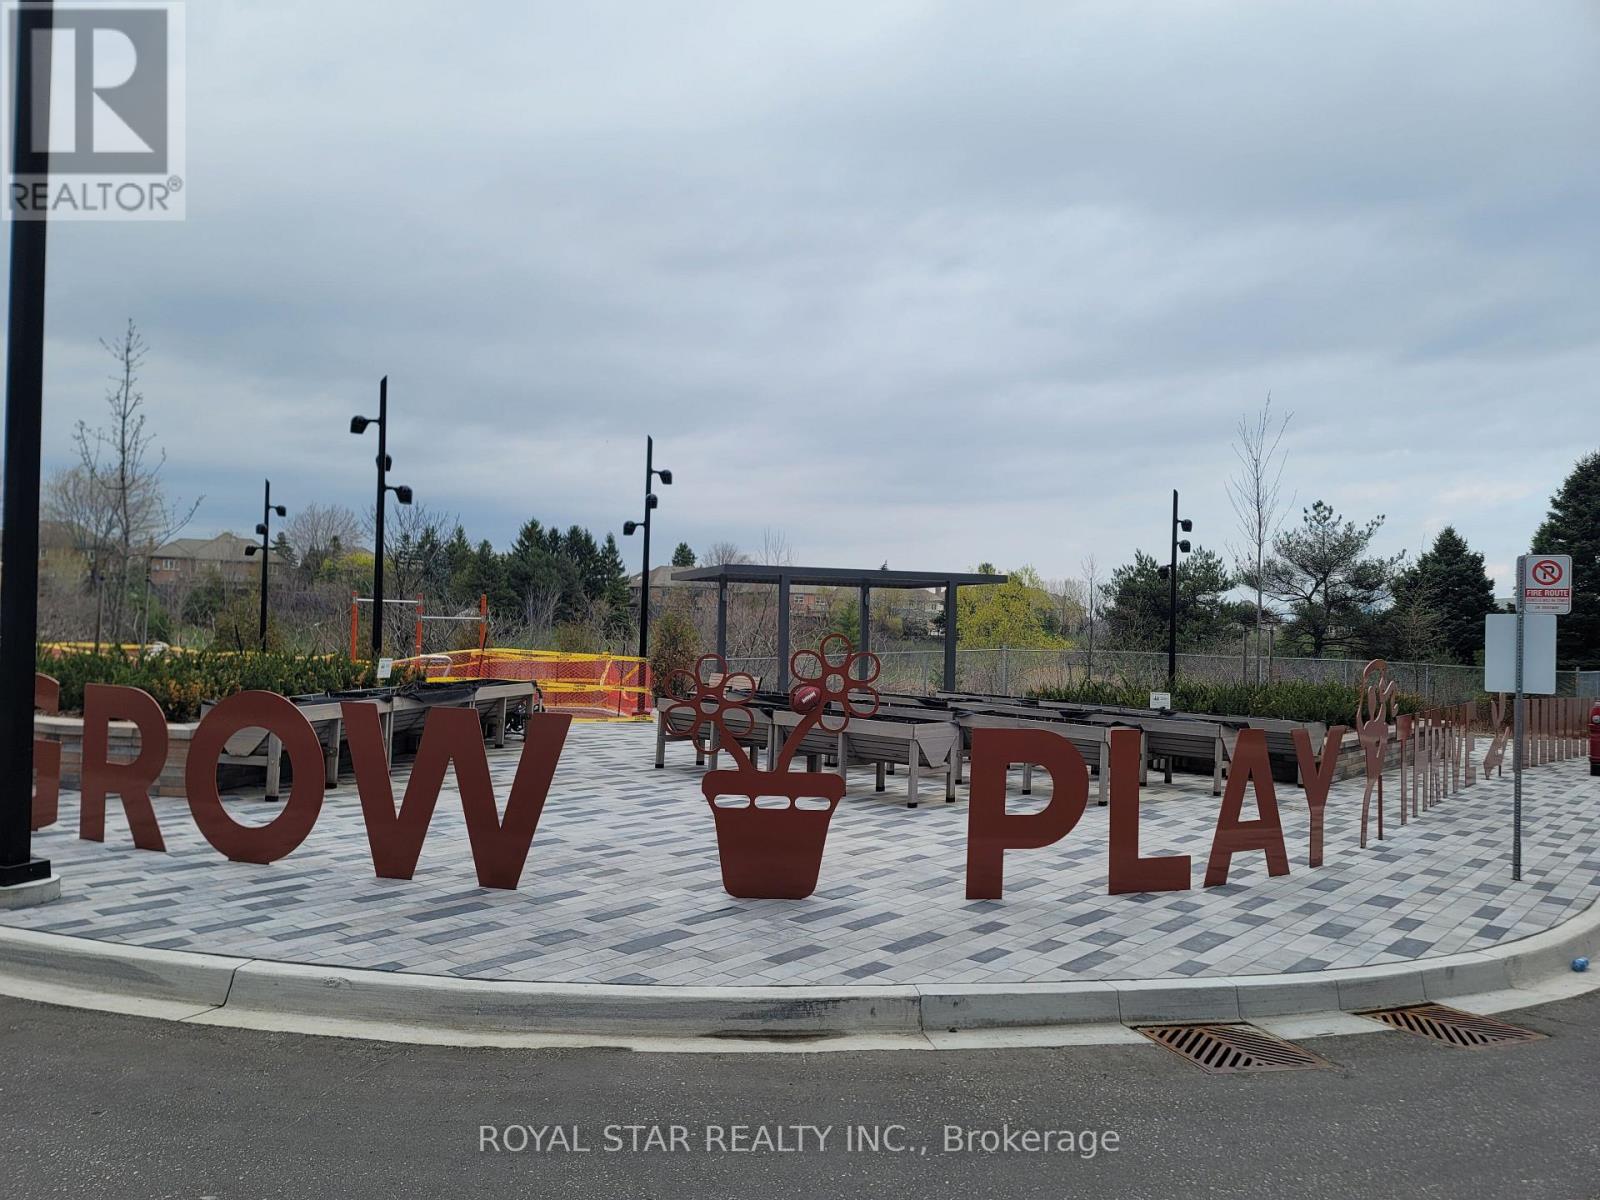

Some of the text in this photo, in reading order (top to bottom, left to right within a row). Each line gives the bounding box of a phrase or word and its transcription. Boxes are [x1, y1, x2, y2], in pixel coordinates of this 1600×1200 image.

[1526, 589, 1569, 597] FIRE ROUTE
[965, 724, 1346, 900] PLAY
[1396, 702, 1477, 826] THRIVE
